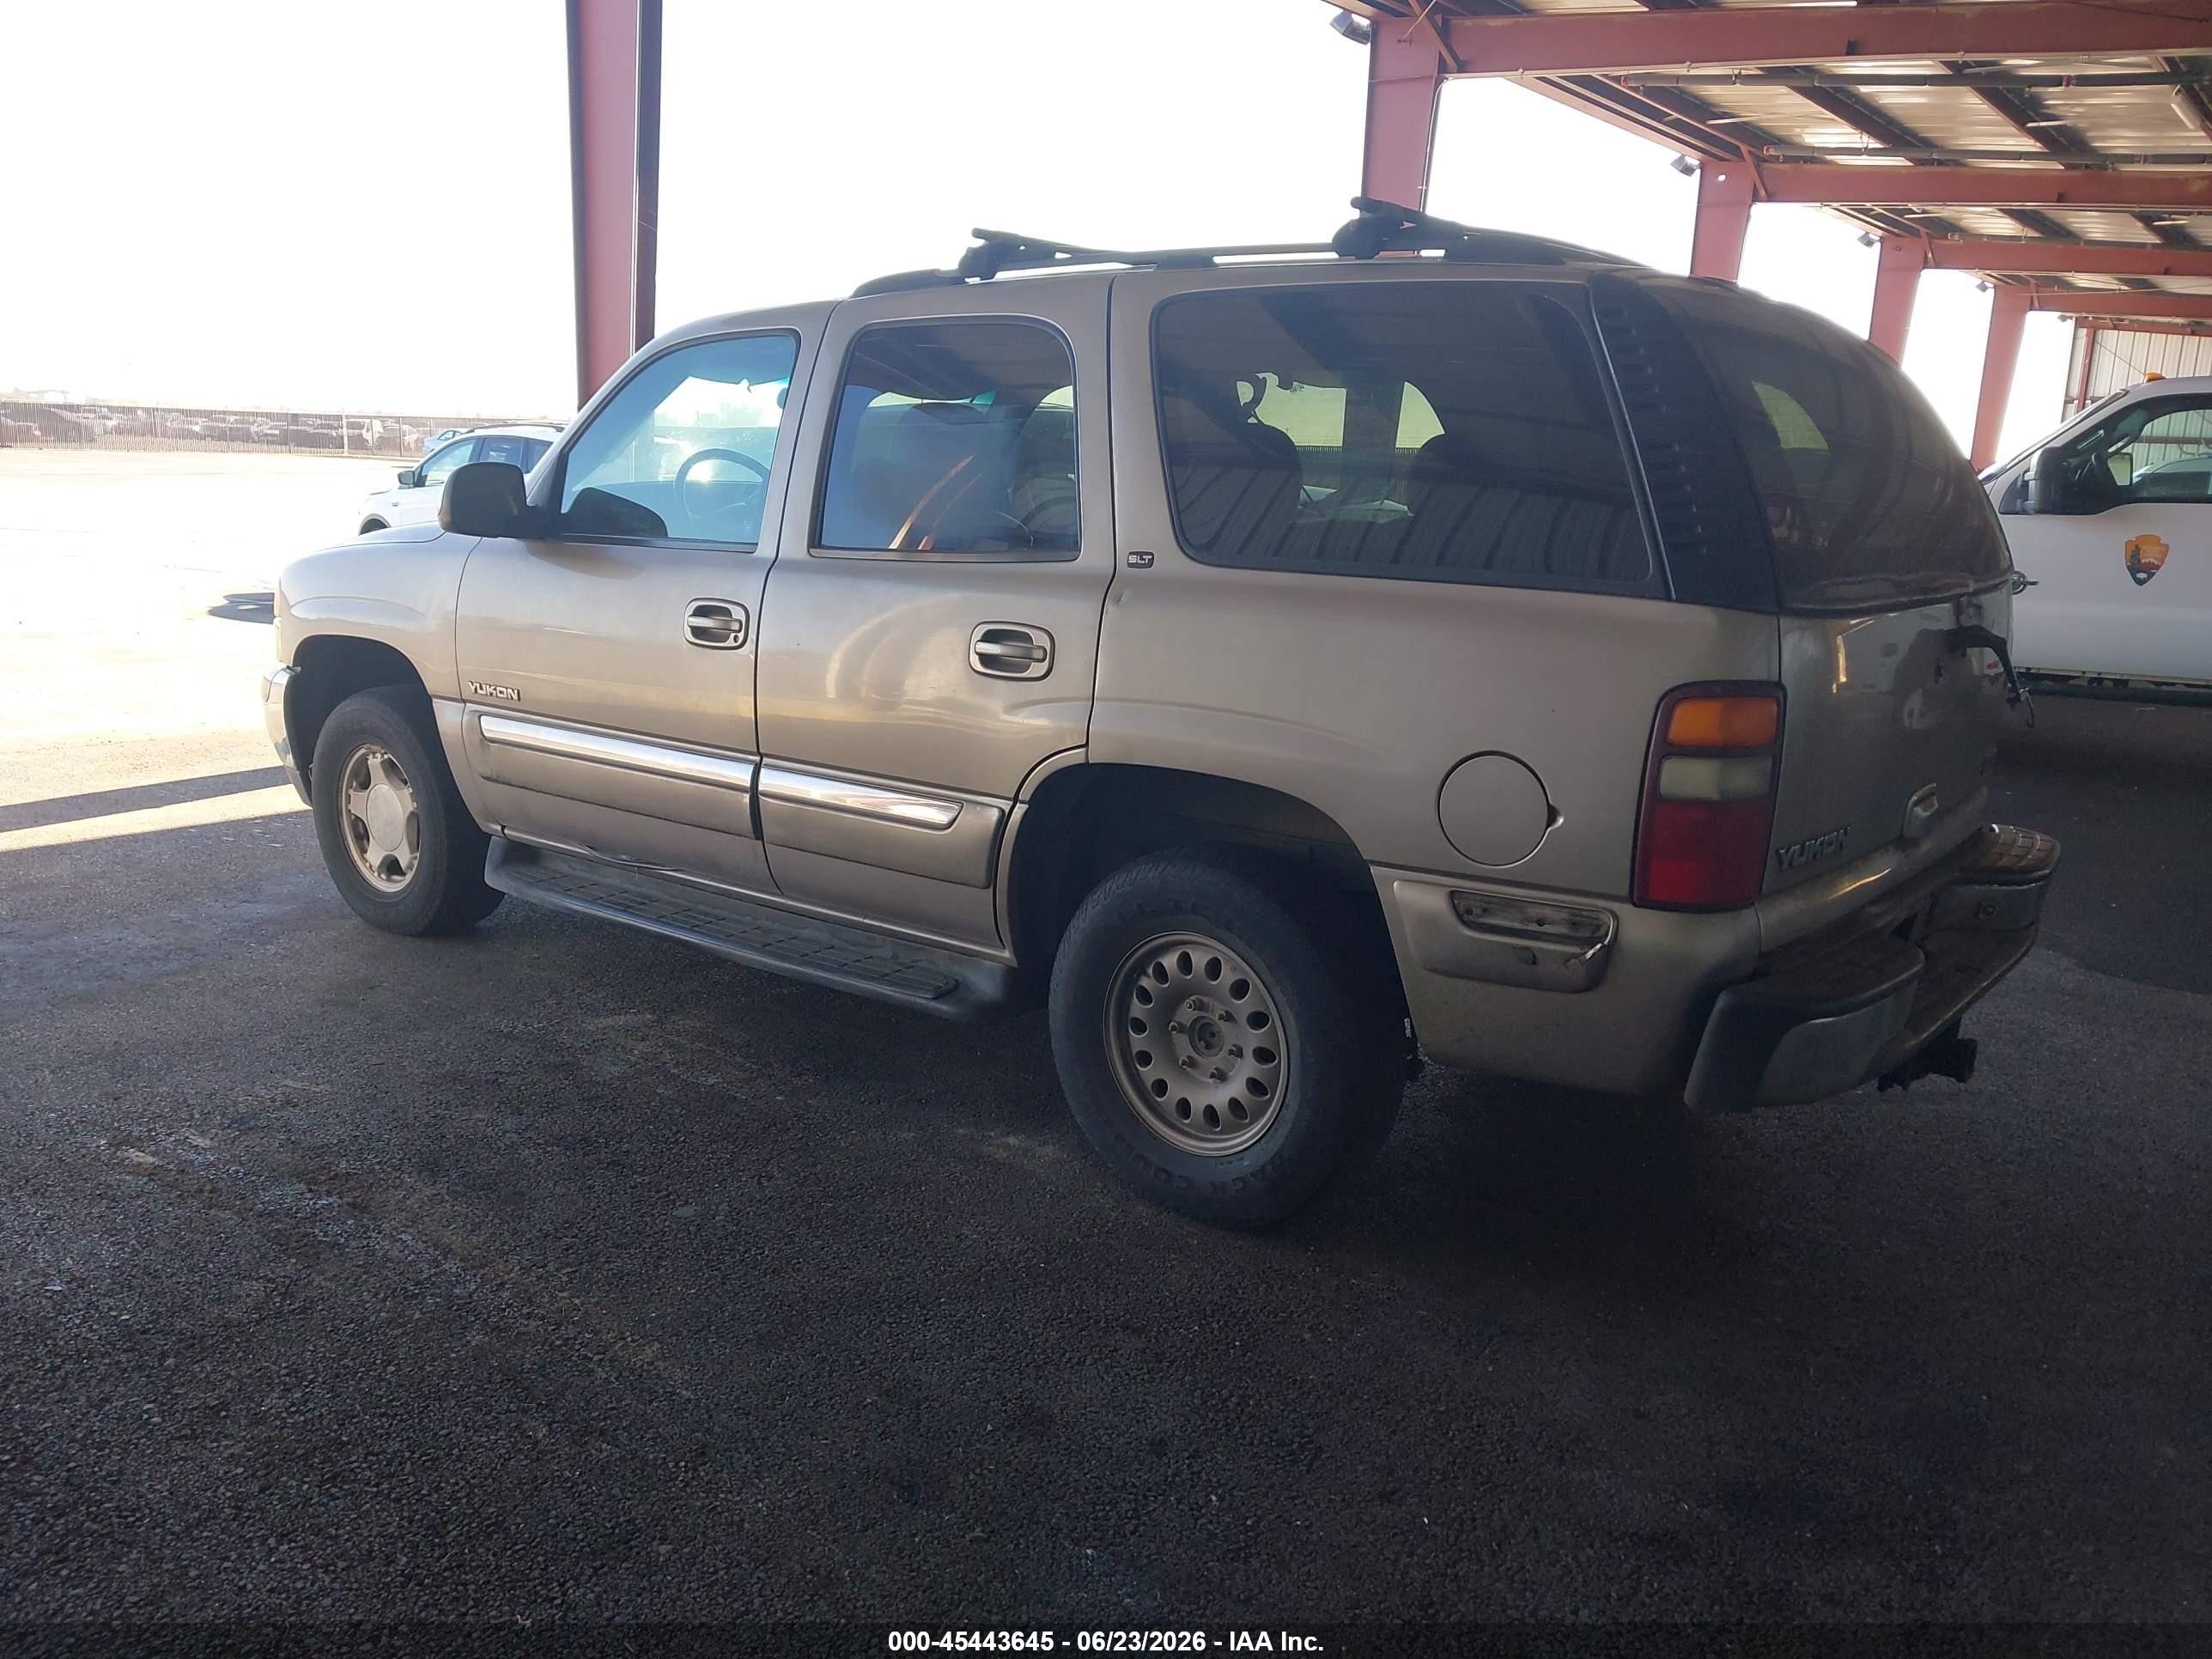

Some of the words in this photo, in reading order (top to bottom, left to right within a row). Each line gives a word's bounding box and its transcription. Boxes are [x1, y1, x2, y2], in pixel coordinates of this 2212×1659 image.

[1127, 554, 1152, 564] SLT
[467, 680, 521, 702] YUKON
[1776, 824, 1851, 871] YUKON
